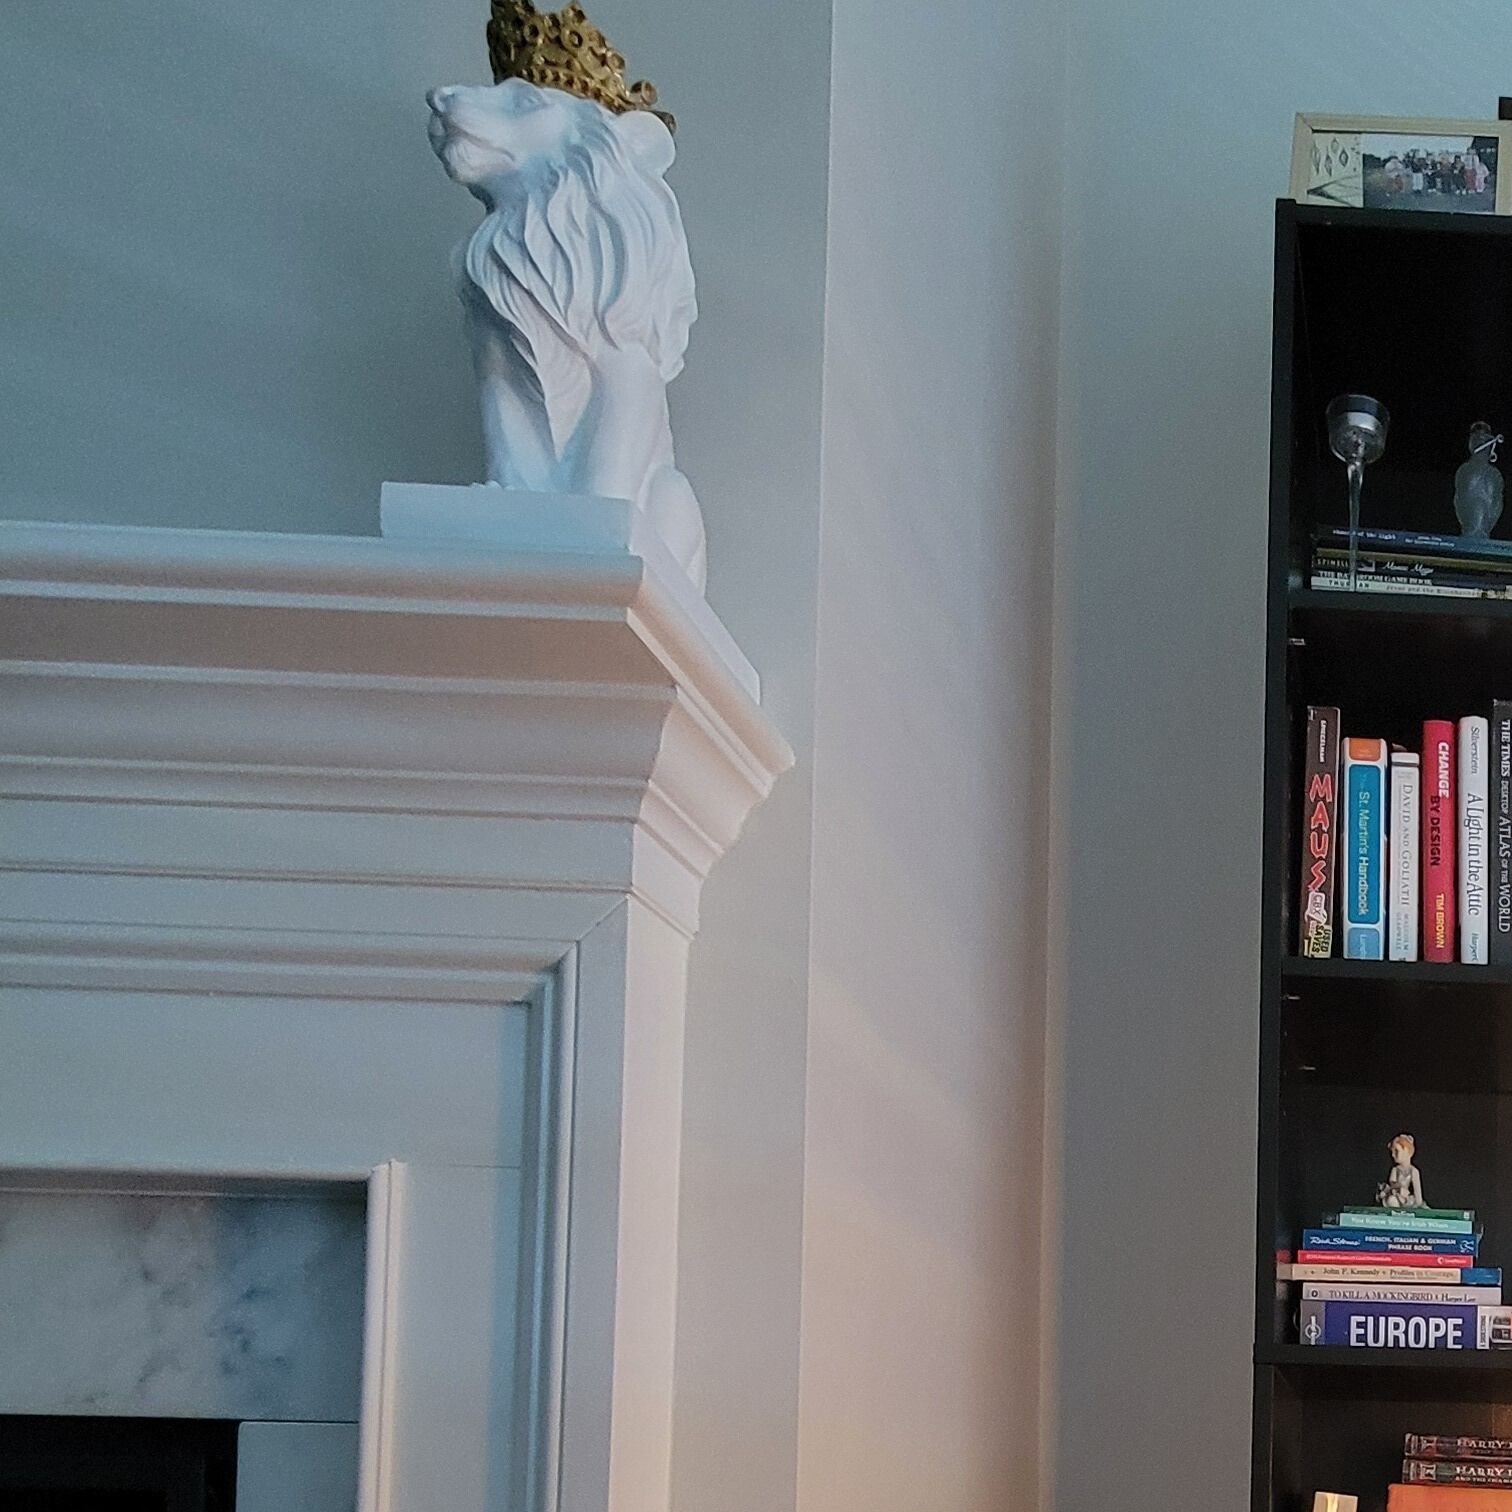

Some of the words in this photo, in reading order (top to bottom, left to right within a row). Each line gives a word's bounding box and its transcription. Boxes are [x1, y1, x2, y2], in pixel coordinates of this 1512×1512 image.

[1500, 719, 1511, 743] THE
[1470, 725, 1481, 775] Silverstein
[1500, 744, 1511, 777] TIMES
[1438, 741, 1450, 799] CHANGE
[1358, 791, 1370, 807] St.
[1400, 784, 1413, 823] DAVID
[1430, 795, 1440, 815] BY
[1467, 792, 1483, 806] A
[1309, 773, 1333, 892] MAUS
[1358, 809, 1370, 855] Martin's
[1402, 825, 1410, 847] AND
[1463, 806, 1485, 842] Light
[1498, 816, 1511, 858] ATLAS
[1429, 816, 1441, 867] DESIGN
[1467, 843, 1483, 857] in
[1401, 850, 1413, 906] GOLIATH
[1468, 859, 1483, 881] the
[1500, 858, 1508, 869] OF
[1358, 856, 1370, 916] Handbook
[1466, 882, 1483, 917] Attic
[1436, 893, 1445, 911] TIM
[1498, 884, 1511, 932] WORLD
[1312, 925, 1324, 954] SAVES
[1321, 928, 1332, 953] USED
[1435, 912, 1445, 949] BROWN
[1427, 1237, 1457, 1246] GERMAN
[1323, 1268, 1340, 1276] John
[1329, 1290, 1341, 1299] TO
[1342, 1290, 1360, 1300] KILL
[1373, 1291, 1433, 1301] MOCKINGBIRD
[1351, 1316, 1463, 1348] EUROPE
[1457, 1439, 1504, 1450] HARRY
[1456, 1466, 1504, 1478] HARRY
